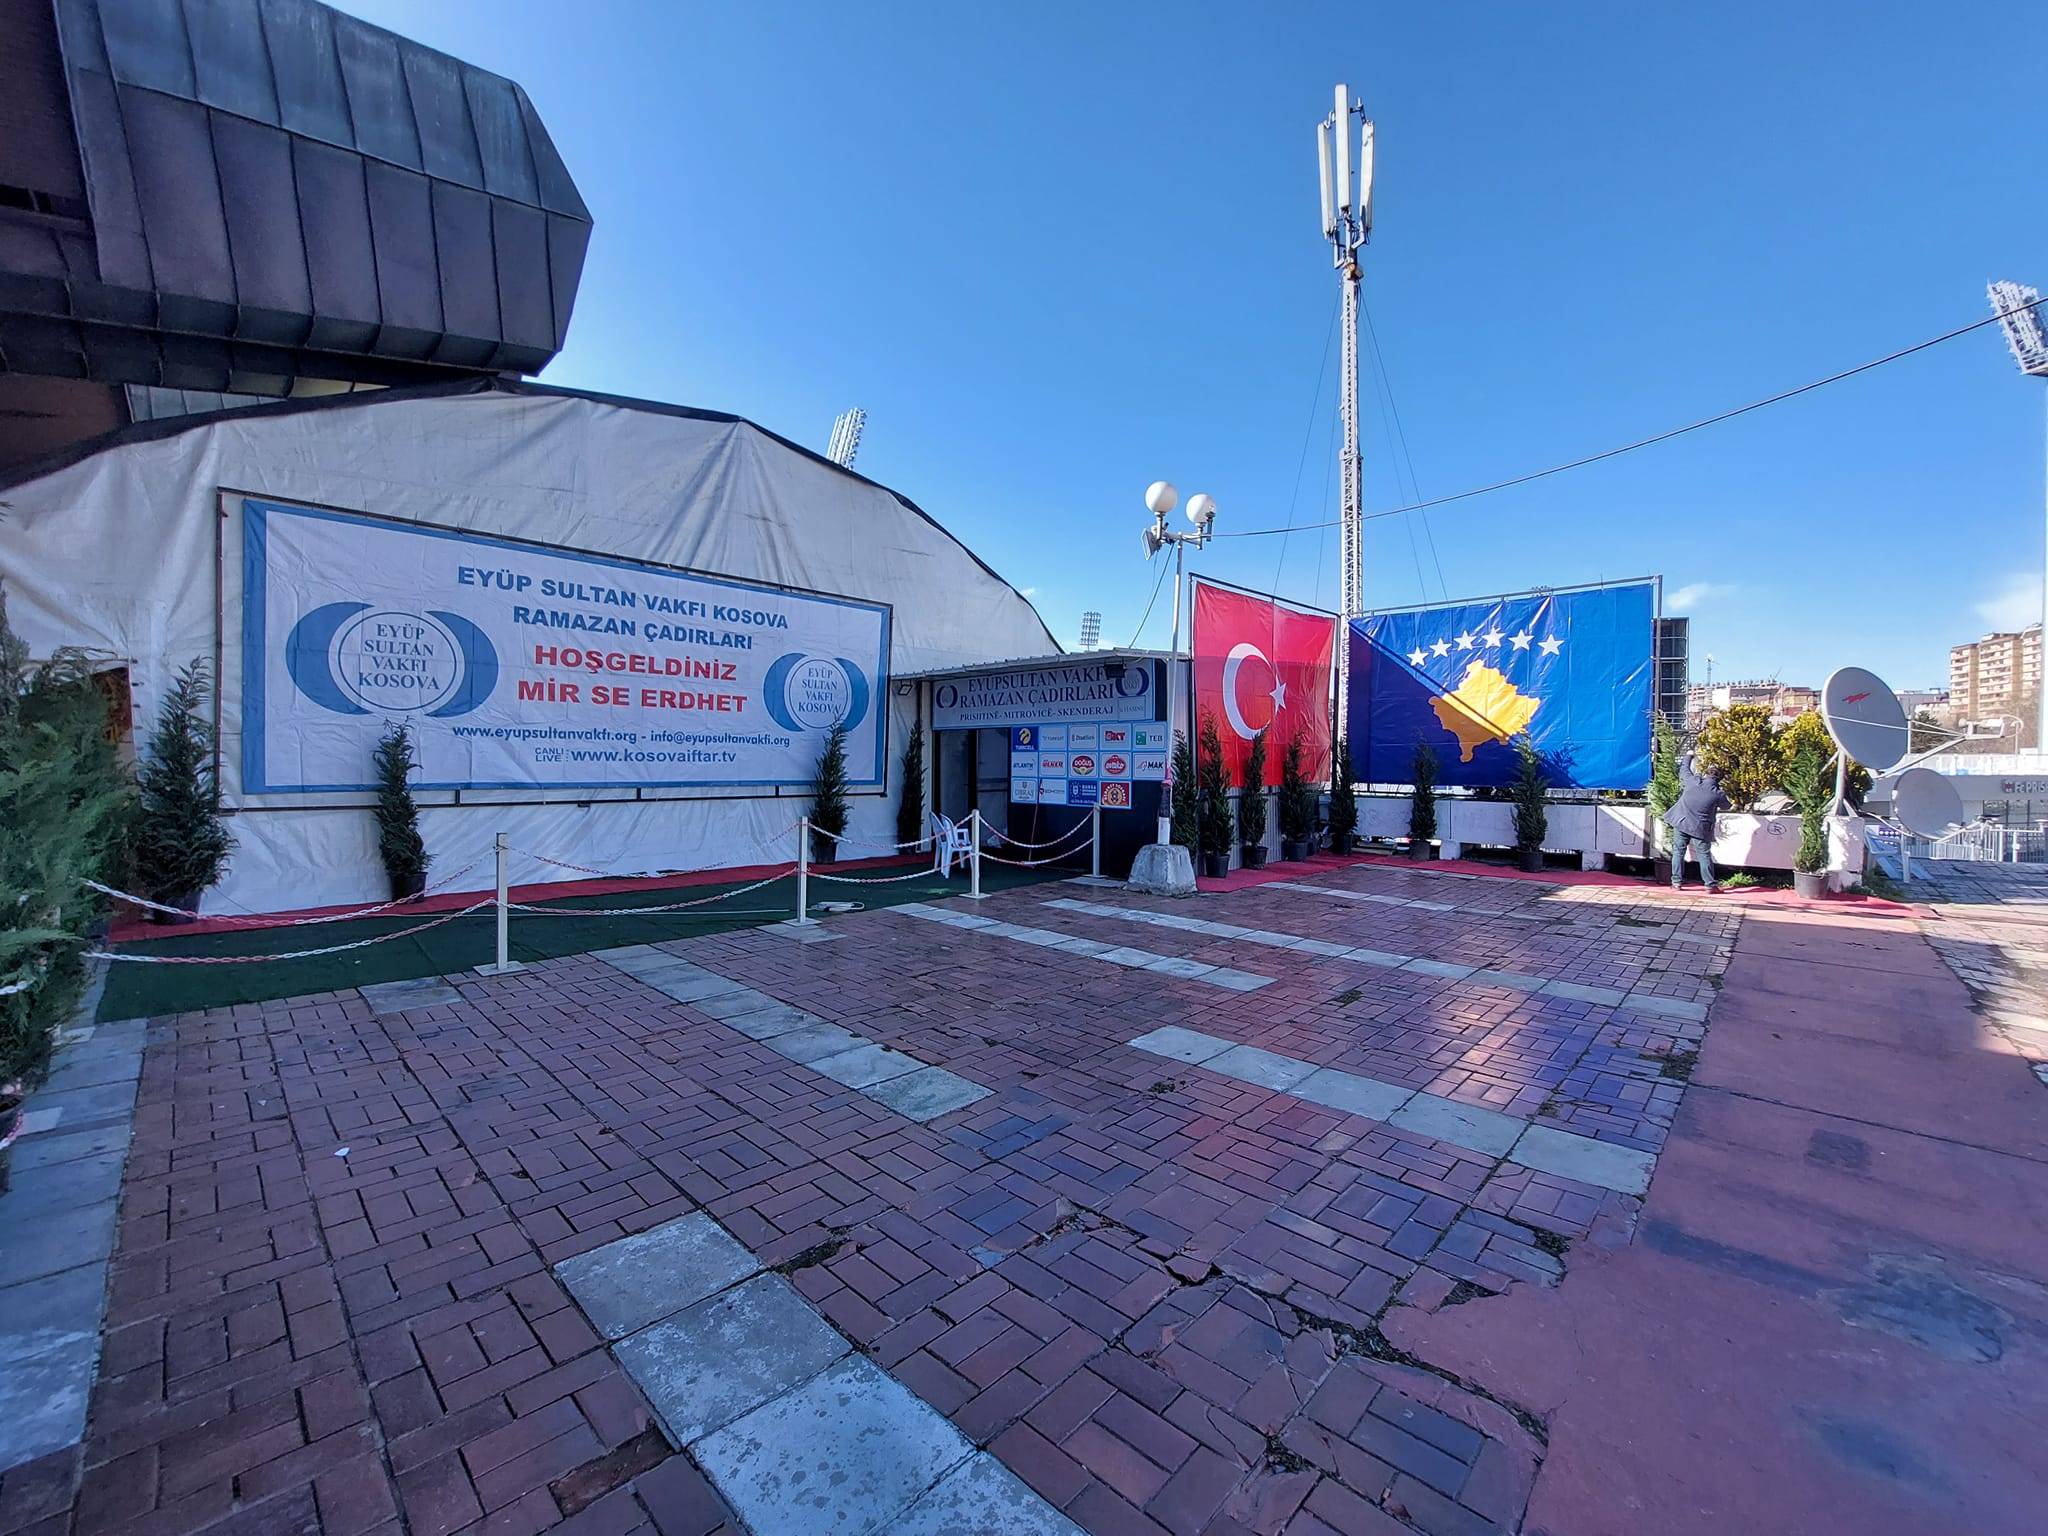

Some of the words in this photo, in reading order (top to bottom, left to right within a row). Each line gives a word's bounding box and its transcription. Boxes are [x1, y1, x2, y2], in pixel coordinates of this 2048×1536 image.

[458, 566, 531, 592] EYÜP
[541, 579, 636, 607] SULTAN
[643, 594, 706, 617] VAKFI
[713, 606, 788, 629] KOSOVA
[377, 623, 425, 640] EYÜP
[513, 606, 636, 636] RAMAZAN
[644, 623, 752, 649] ÇADIRLARI
[364, 640, 434, 657] SULTAN
[372, 657, 427, 672] VAKFI
[535, 645, 737, 681] HOŞGELDİNİZ
[808, 665, 833, 678] EYÜP
[359, 672, 440, 690] KOSOVA
[1061, 665, 1110, 684] VAKF
[801, 679, 838, 690] SULTAN
[518, 678, 581, 703] MİR
[591, 686, 630, 706] SE
[641, 689, 747, 712] ERDHET
[806, 690, 833, 701] VAKFI
[960, 690, 1024, 709] RAMAZAN
[1028, 682, 1114, 707] ÇADIRLARI
[798, 702, 840, 714] KOSOVA
[1057, 705, 1114, 718] SKENDERAJ
[571, 748, 736, 762] www.kosovaiftar.tv
